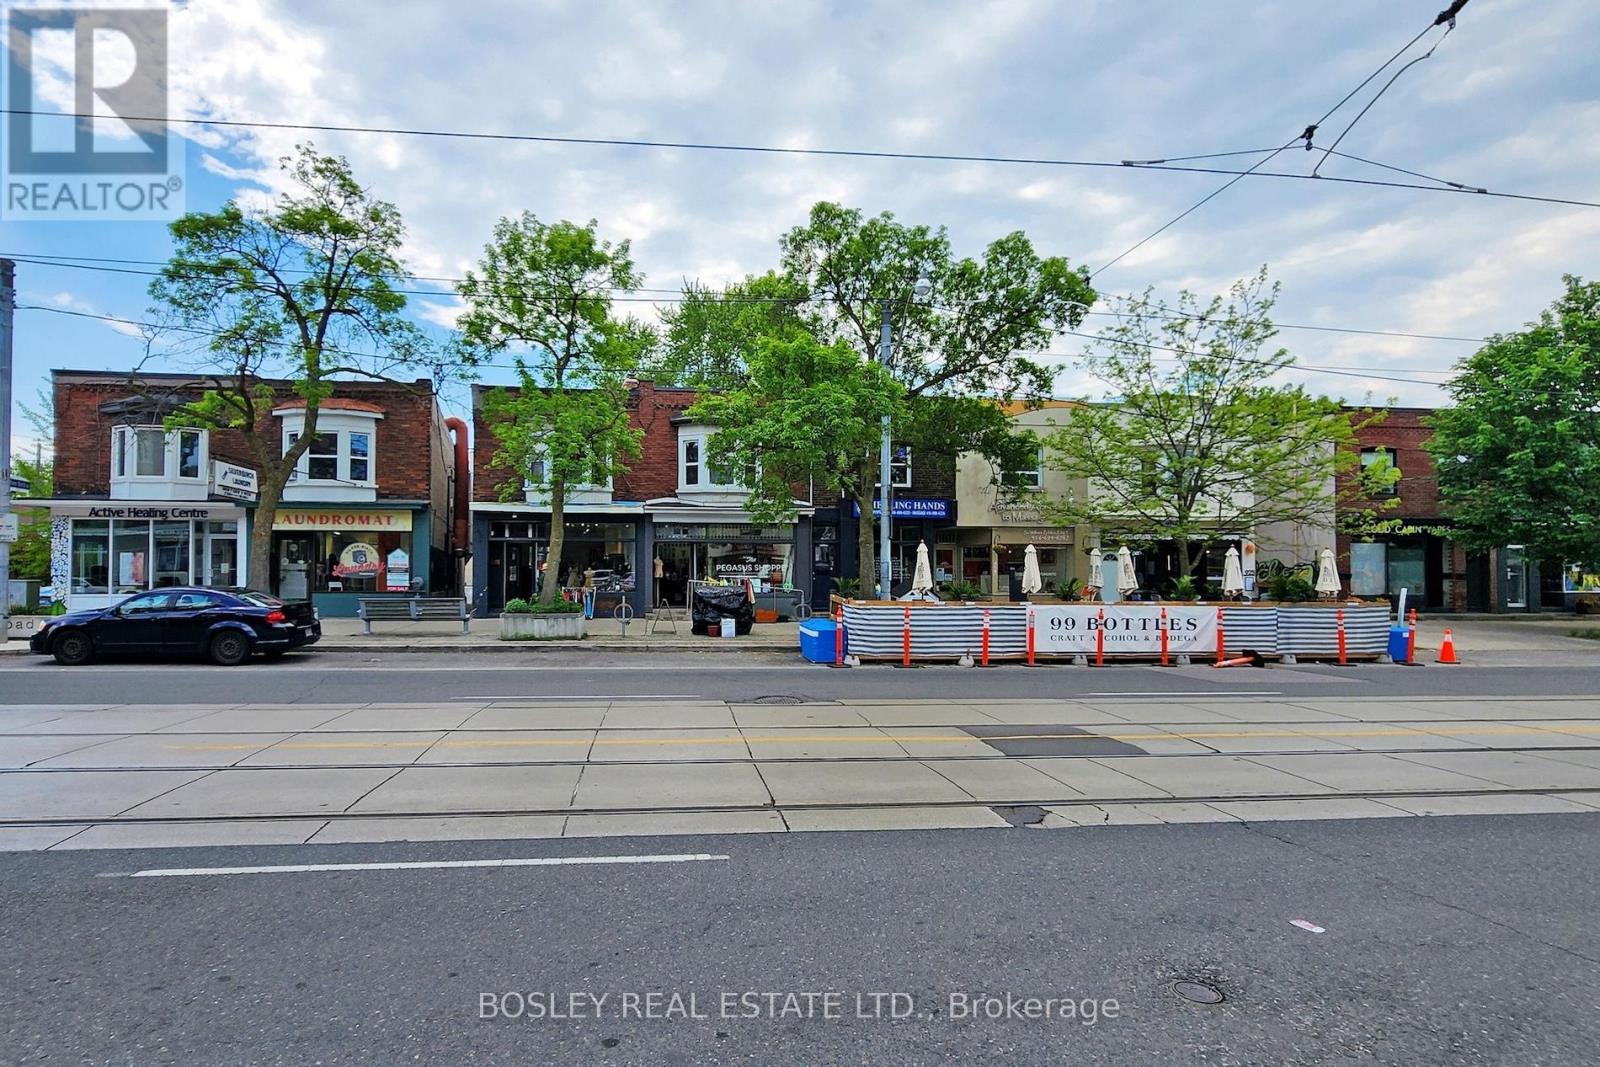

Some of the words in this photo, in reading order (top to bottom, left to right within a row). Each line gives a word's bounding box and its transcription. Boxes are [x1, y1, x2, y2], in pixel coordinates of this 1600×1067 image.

[914, 501, 946, 510] HANDS
[88, 507, 125, 518] Active
[127, 507, 168, 520] Healing
[171, 507, 209, 519] Centre
[716, 564, 753, 572] PEGASUS
[754, 564, 786, 572] SHOPPE
[1050, 617, 1076, 631] 99
[1050, 634, 1084, 642] CRAFT
[1089, 634, 1139, 642] ACOHOL
[1143, 634, 1150, 642] &
[1155, 634, 1198, 642] BDEGA
